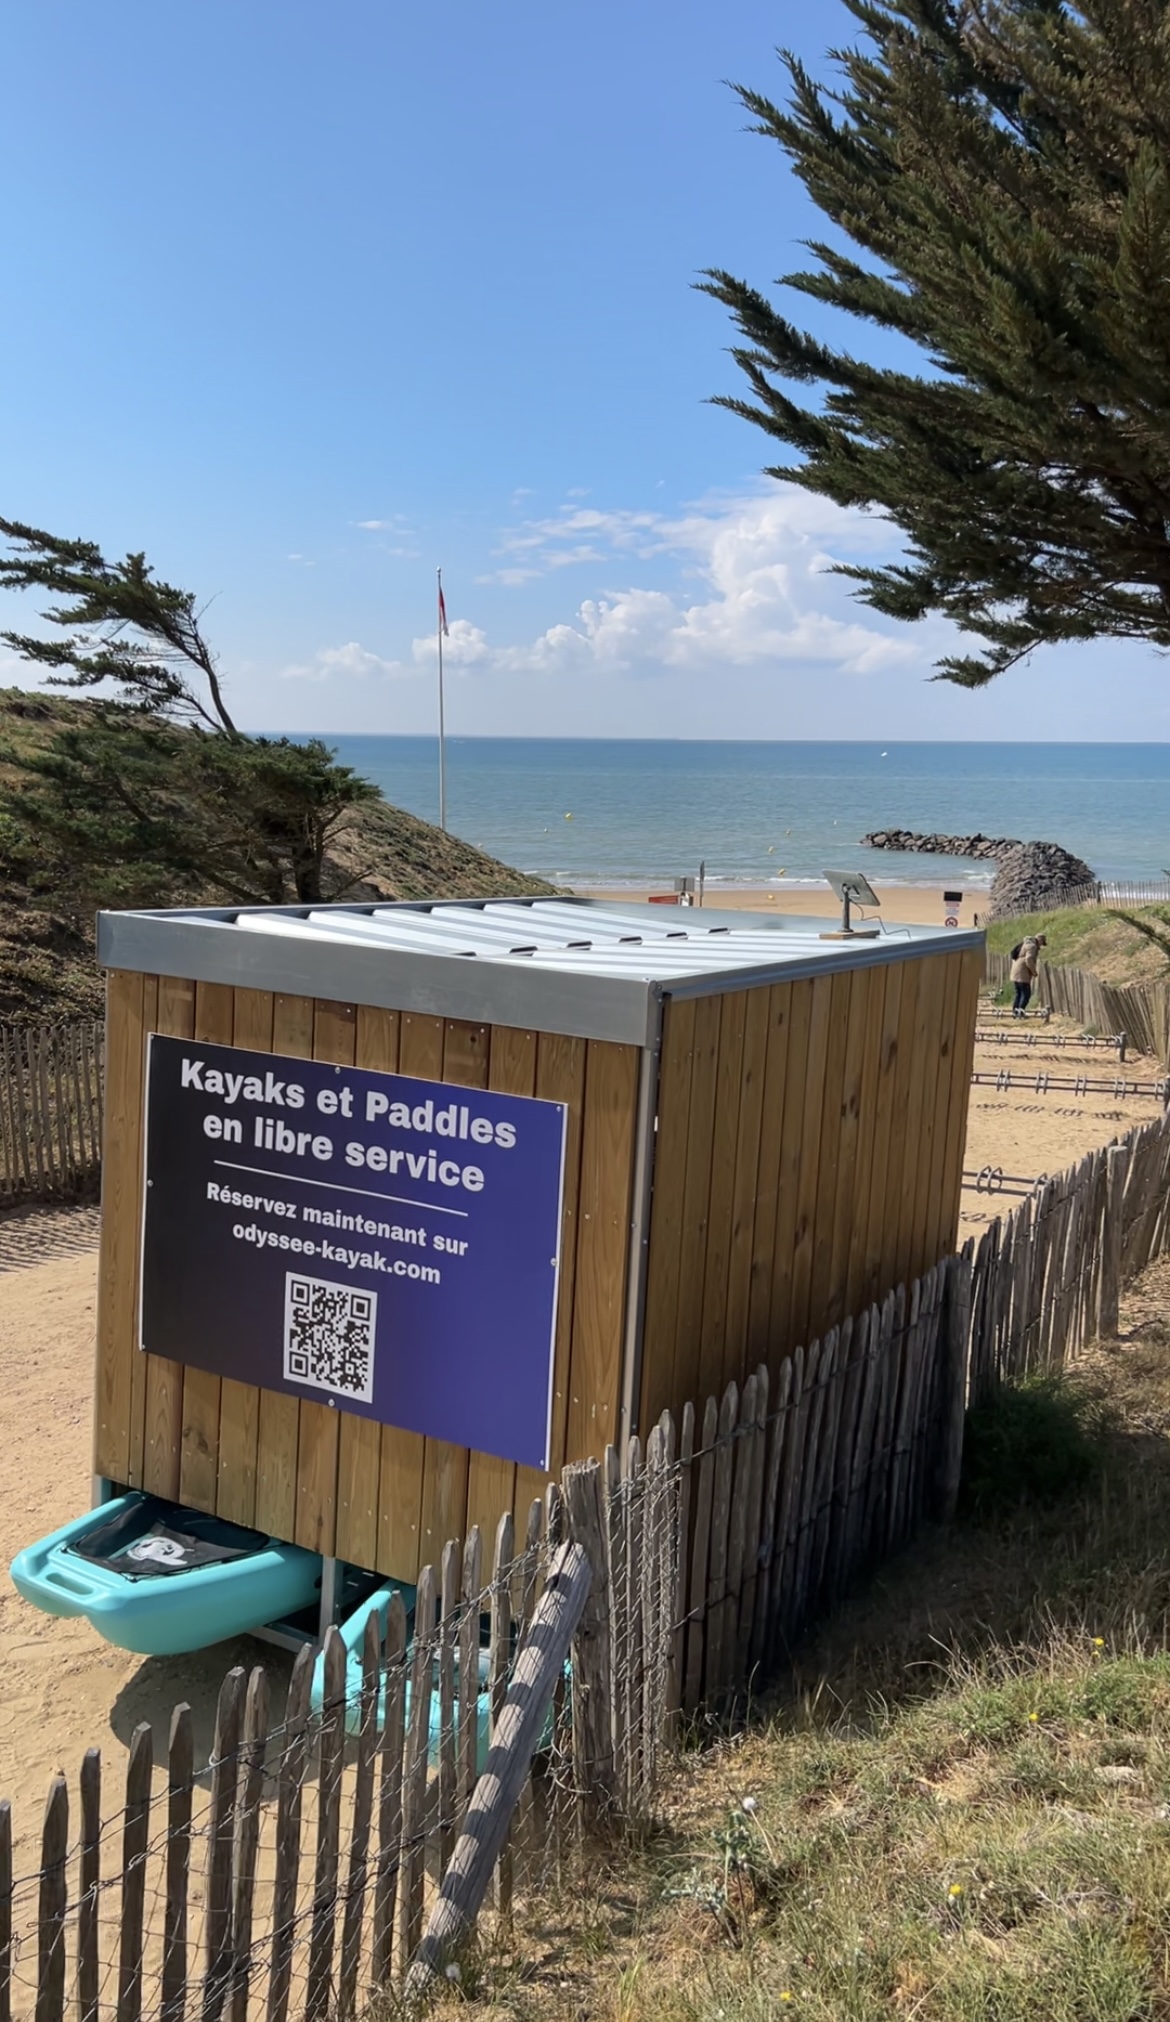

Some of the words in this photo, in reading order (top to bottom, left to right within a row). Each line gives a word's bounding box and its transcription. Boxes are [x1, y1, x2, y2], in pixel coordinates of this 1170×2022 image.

[180, 1058, 304, 1109] Kayaks
[317, 1086, 354, 1117] et
[365, 1091, 517, 1148] Paddles
[203, 1114, 242, 1143] en
[254, 1116, 333, 1160] libre
[345, 1141, 485, 1192] service
[206, 1182, 297, 1218] Réservez
[302, 1204, 427, 1247] maintenant
[432, 1233, 468, 1256] sur
[232, 1224, 441, 1284] odyssee-kayak.com
